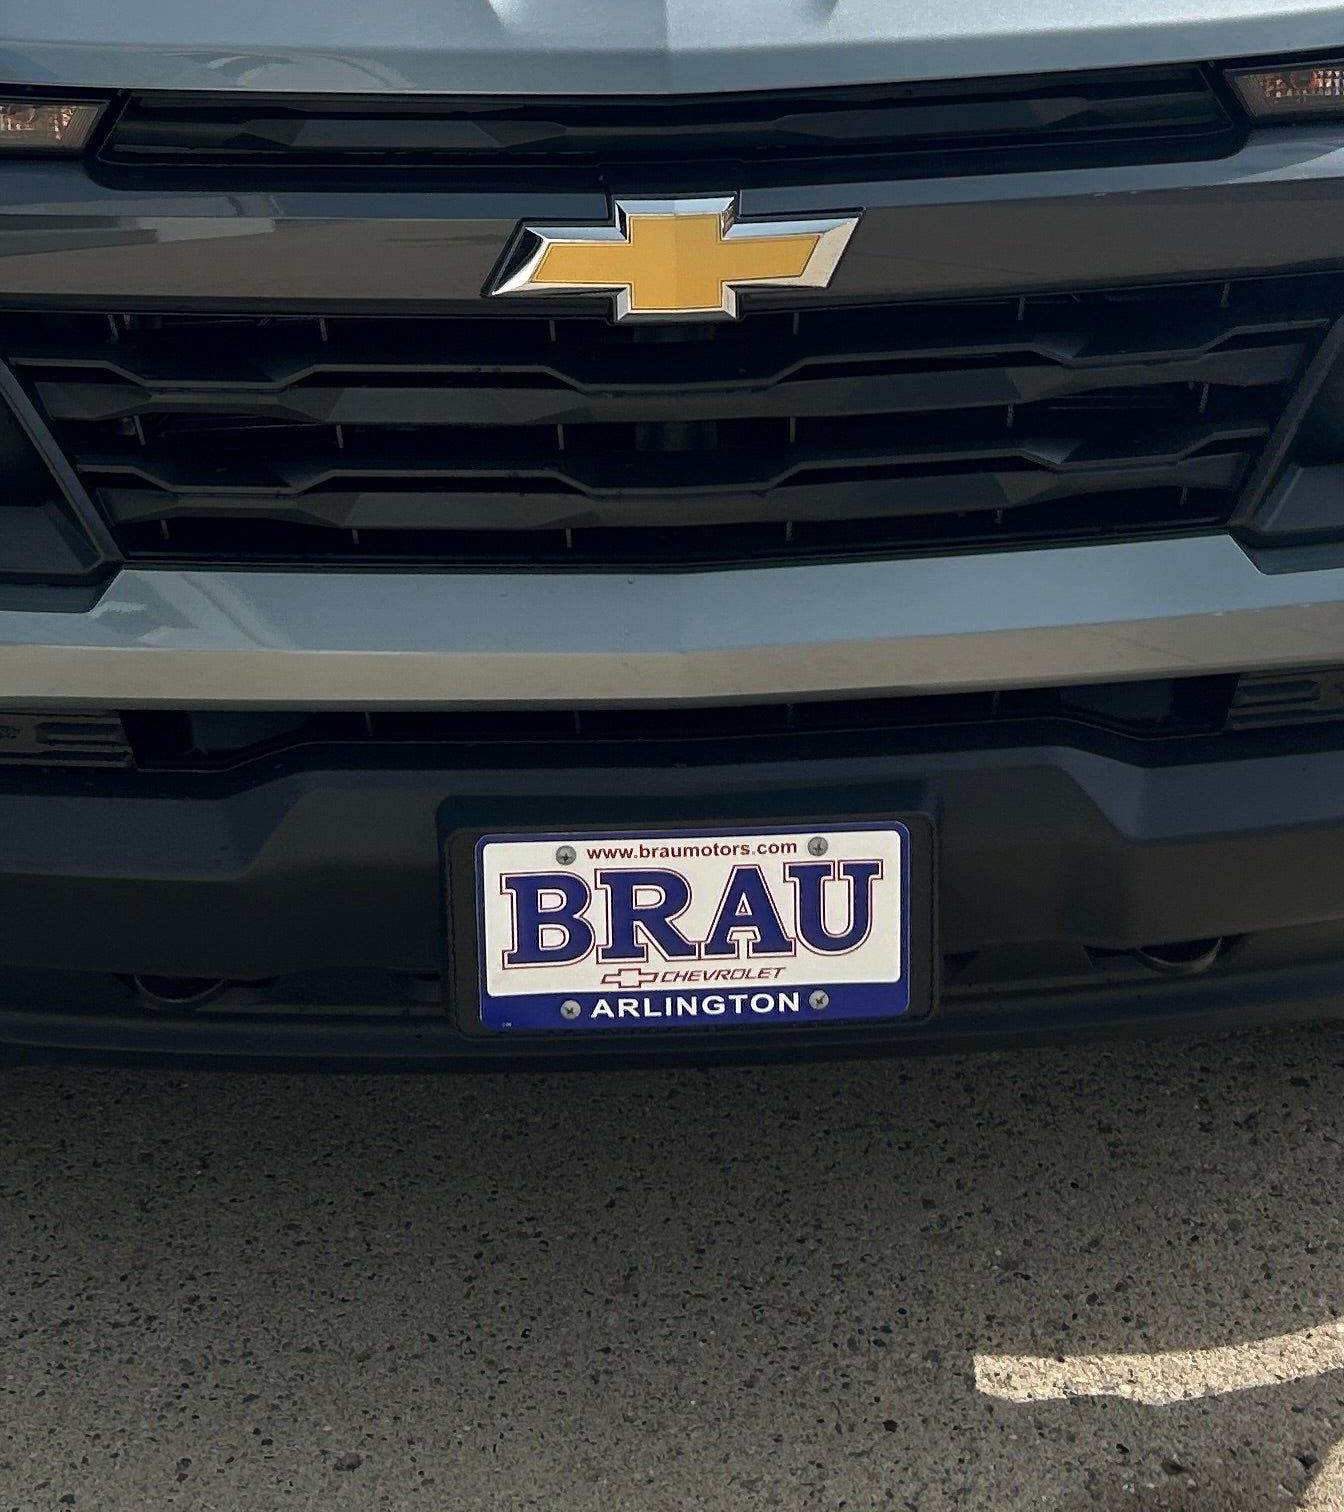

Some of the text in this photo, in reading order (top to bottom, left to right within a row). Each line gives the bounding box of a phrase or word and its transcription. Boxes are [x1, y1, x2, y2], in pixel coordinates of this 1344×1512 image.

[586, 839, 798, 860] www.braumotors.com
[500, 859, 884, 969] BRAU
[660, 967, 787, 984] CHEVROLET
[591, 992, 801, 1019] ARLINGTON
